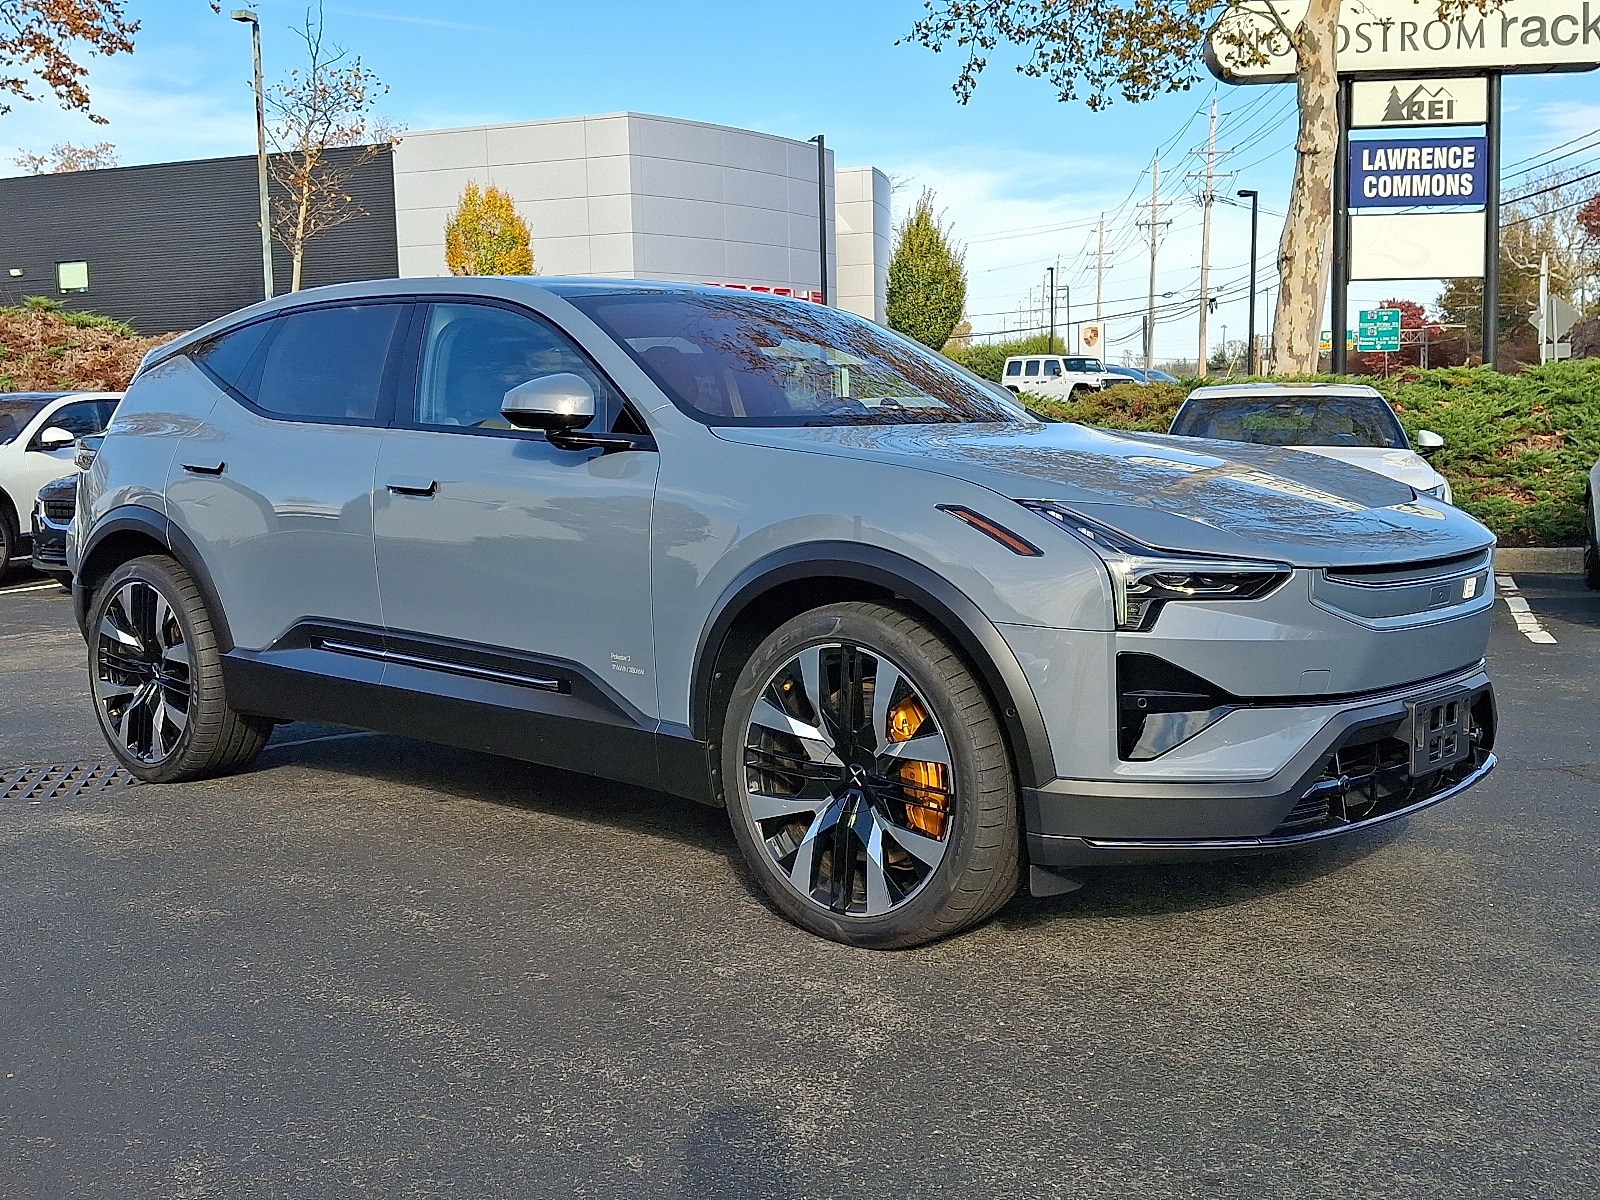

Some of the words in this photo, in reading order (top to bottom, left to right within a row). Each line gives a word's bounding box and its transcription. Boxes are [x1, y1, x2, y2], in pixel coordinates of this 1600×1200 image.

[1238, 18, 1485, 59] NOSTROM
[1501, 1, 1600, 49] rack
[1407, 99, 1455, 121] REI
[1362, 146, 1475, 171] LAWRENCE
[1363, 173, 1473, 198] COMMONS
